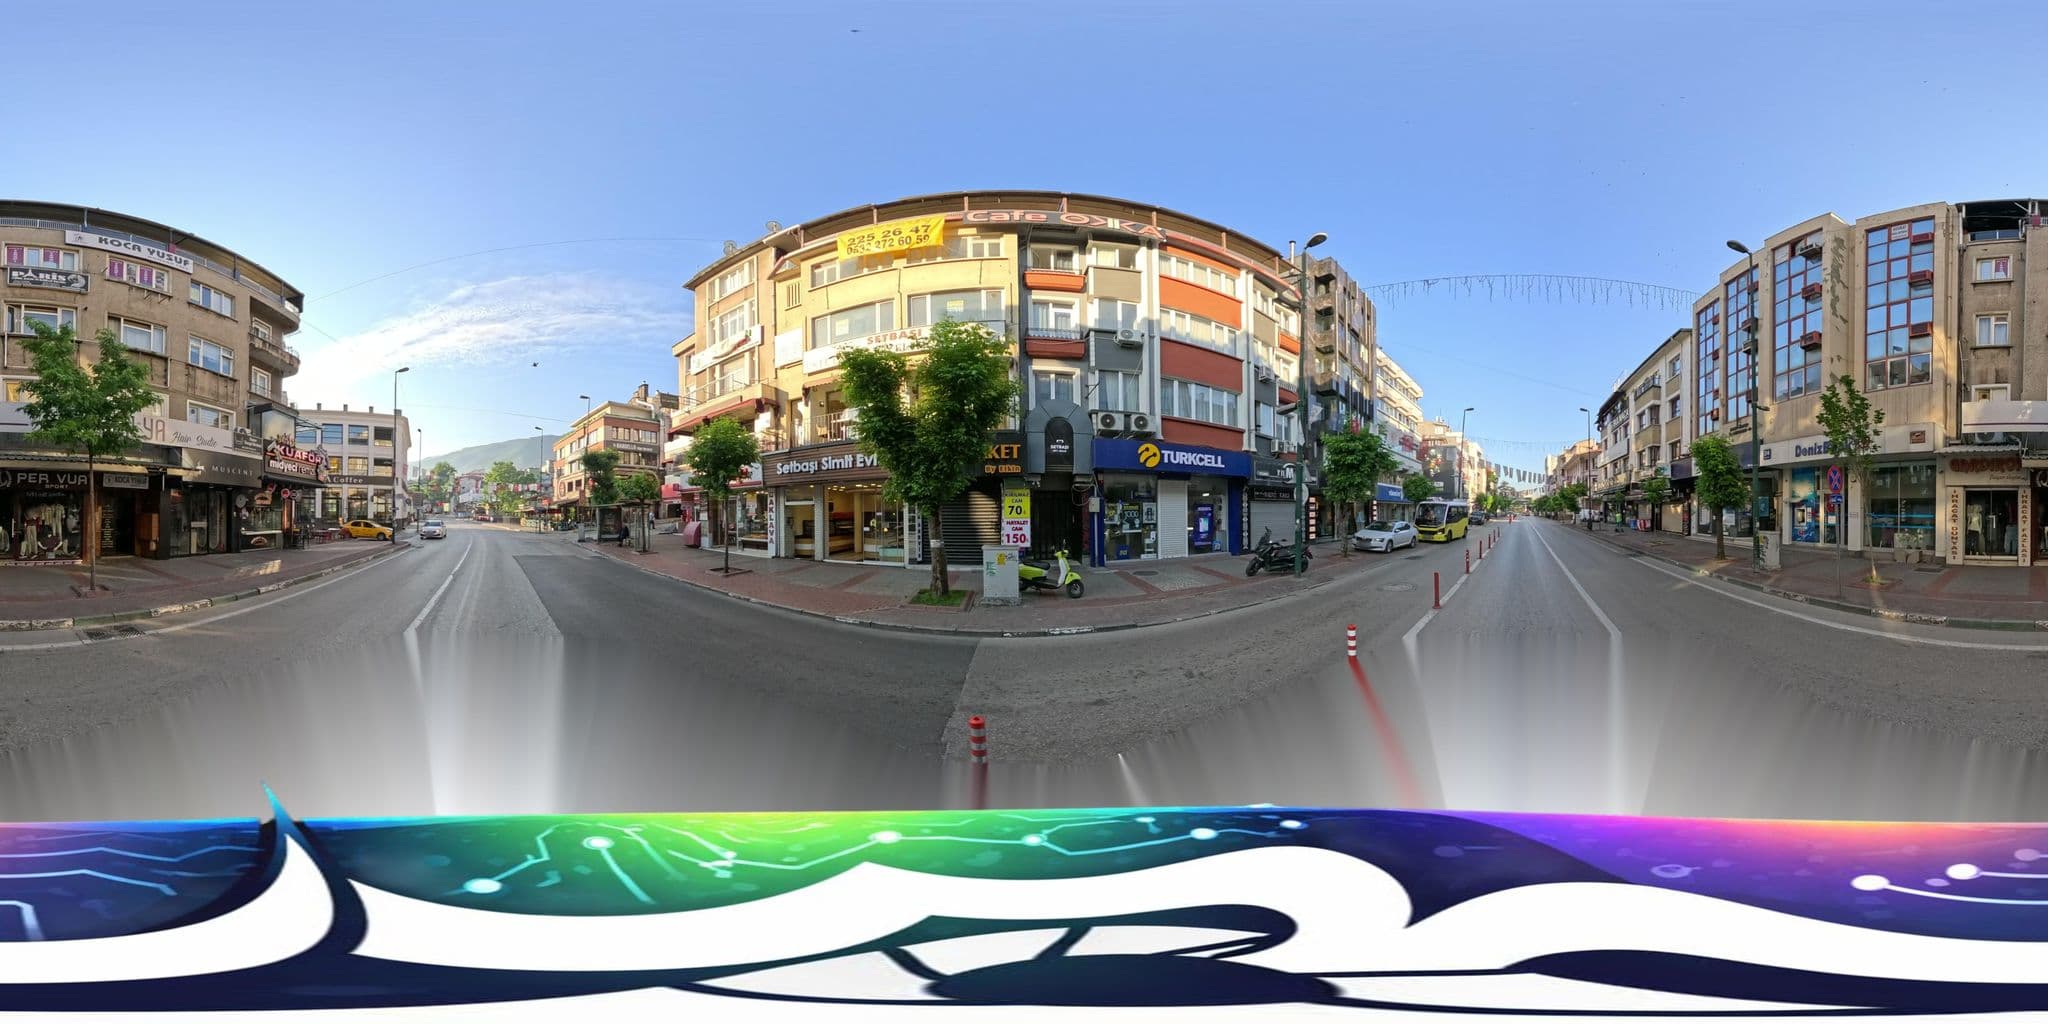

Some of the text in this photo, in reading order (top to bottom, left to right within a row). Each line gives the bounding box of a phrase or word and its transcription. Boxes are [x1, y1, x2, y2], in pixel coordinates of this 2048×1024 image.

[967, 210, 1048, 223] Cafe
[847, 224, 931, 247] 225 26 47
[875, 238, 895, 249] 272
[898, 235, 912, 246] 60
[916, 234, 930, 245] 59
[98, 236, 191, 267] KOCA YUSUF
[1161, 450, 1225, 468] TURKCELL
[211, 465, 254, 477] MUSCENT
[776, 460, 818, 475] Setbaşı
[17, 472, 49, 484] PER
